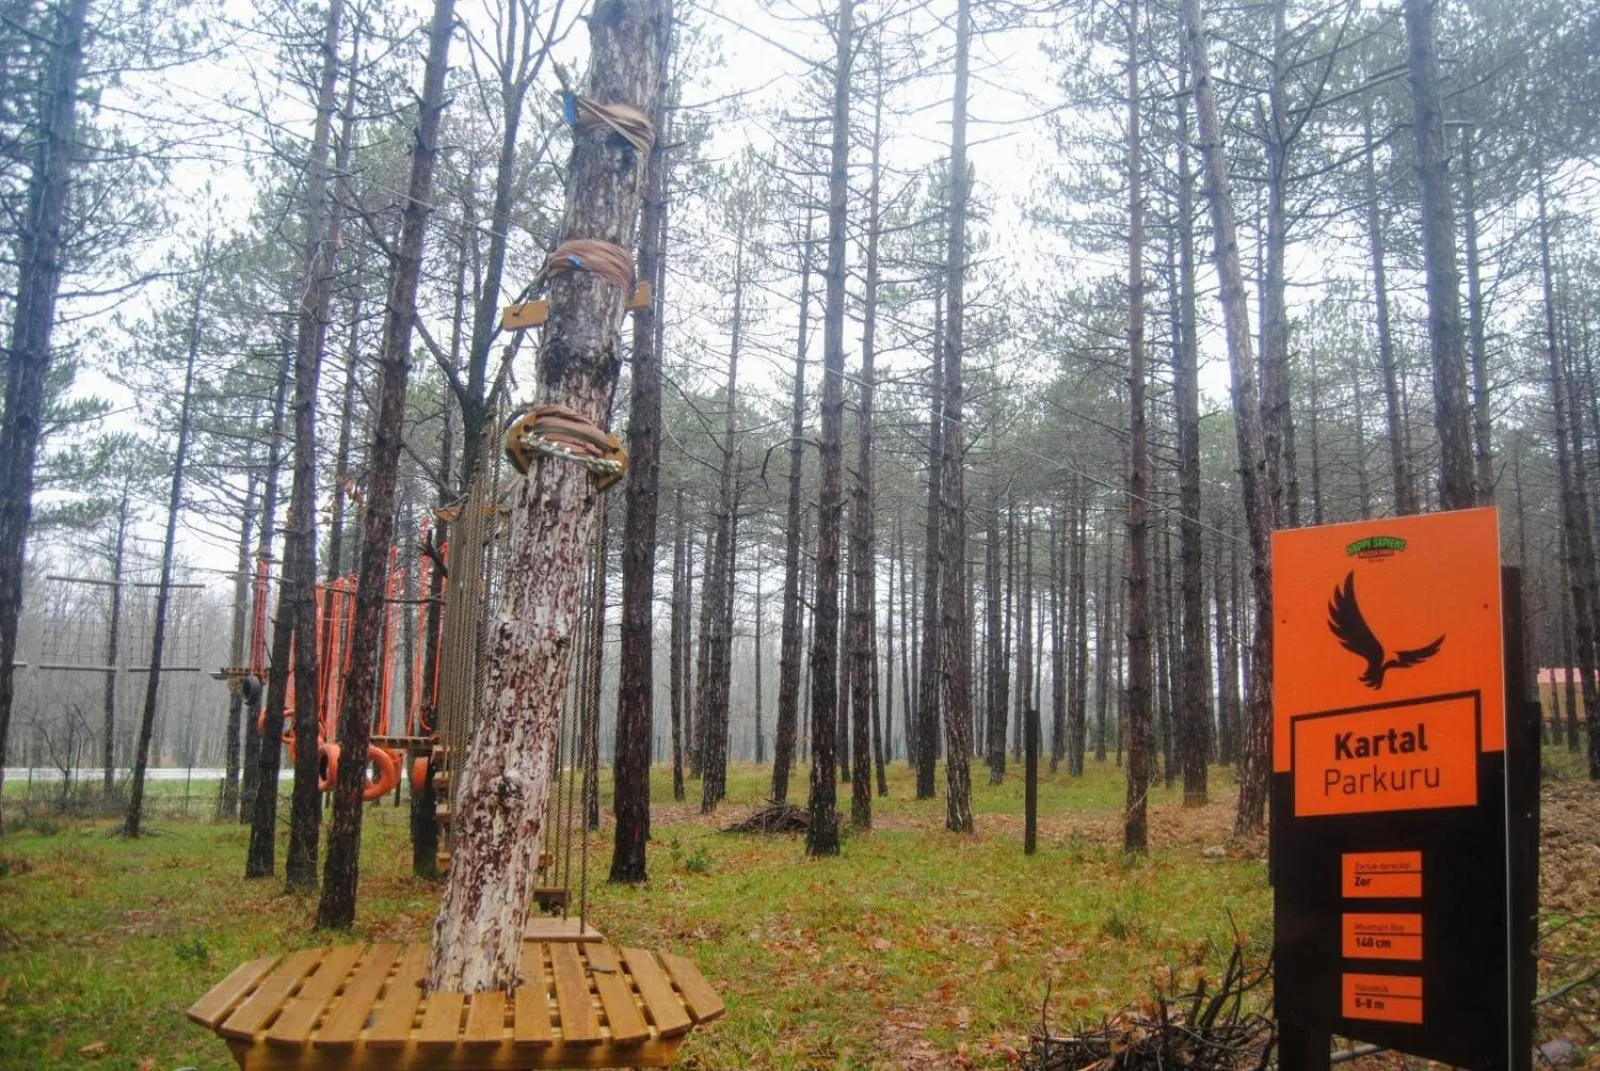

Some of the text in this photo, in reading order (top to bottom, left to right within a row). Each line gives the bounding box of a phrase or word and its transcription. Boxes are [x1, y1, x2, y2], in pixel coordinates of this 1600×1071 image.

[1335, 723, 1428, 760] Kartal
[1324, 764, 1440, 796] Parkuru
[1354, 876, 1372, 888] Zor
[1355, 937, 1392, 949] 140 cm
[1374, 1001, 1385, 1009] m
